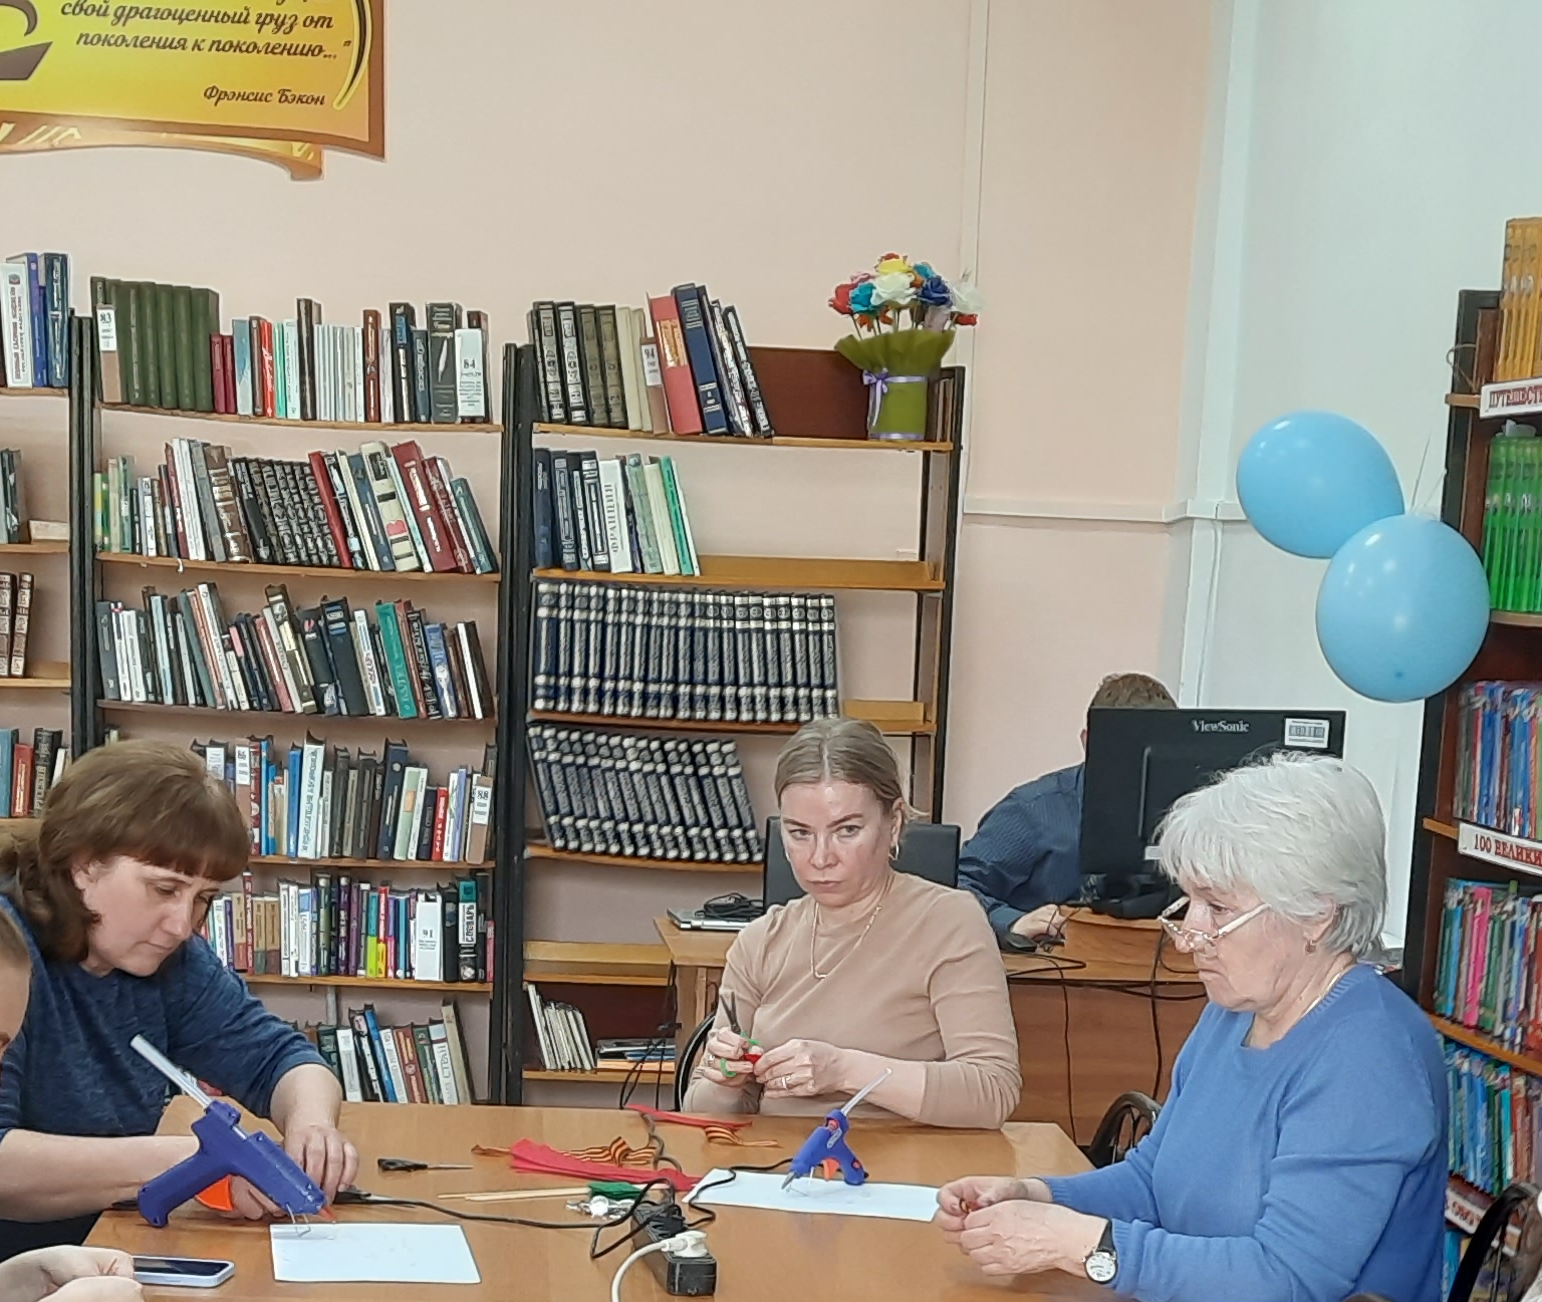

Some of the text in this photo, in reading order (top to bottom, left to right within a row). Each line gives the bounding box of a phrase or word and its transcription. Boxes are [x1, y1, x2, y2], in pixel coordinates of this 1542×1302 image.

[61, 0, 334, 35] свой драгоценный груз от
[76, 31, 187, 51] поколения
[192, 38, 205, 52] к
[204, 85, 326, 107] Фрэнсис Бэкон
[1191, 719, 1250, 733] ViewSonic
[1474, 833, 1492, 853] 100
